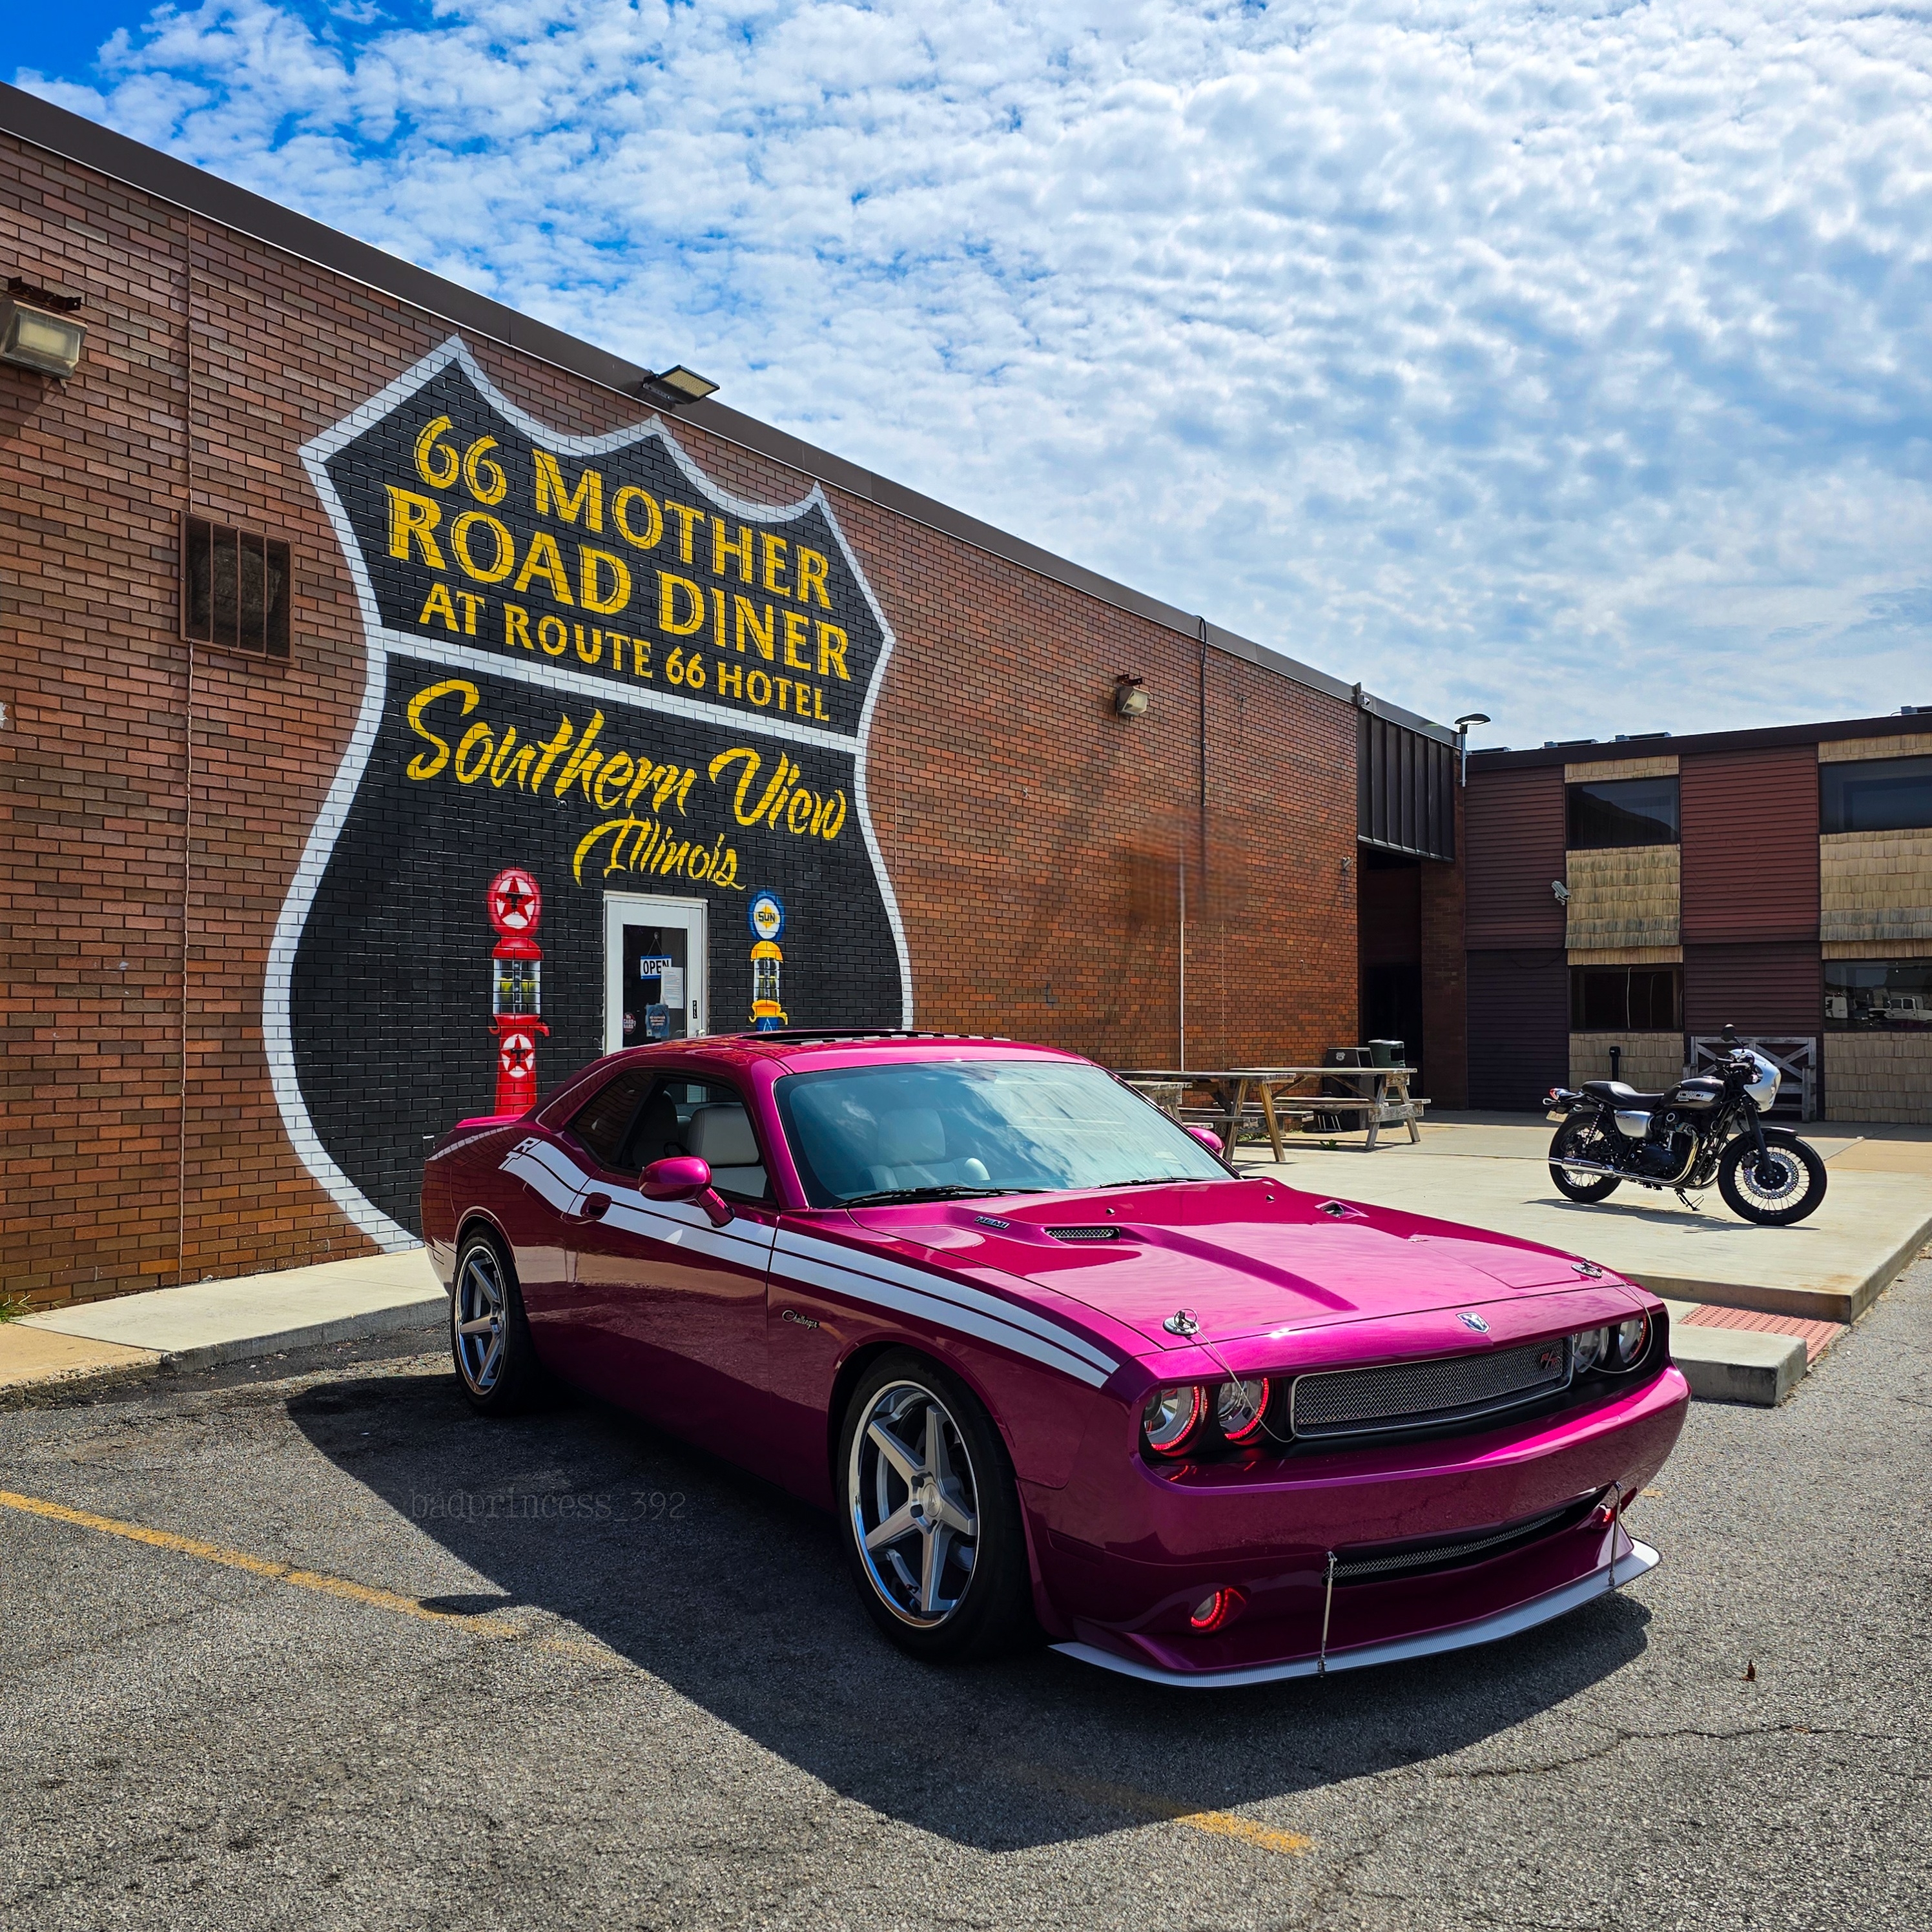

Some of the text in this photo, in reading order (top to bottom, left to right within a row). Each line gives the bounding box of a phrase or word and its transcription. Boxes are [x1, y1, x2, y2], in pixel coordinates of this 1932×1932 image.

[384, 483, 852, 681] ROAD DINER
[413, 415, 832, 610] 66 MOTHER
[418, 582, 831, 721] AT ROUTE 66 HOTEL
[406, 679, 847, 840] Southern View
[573, 811, 747, 890] Illinois
[758, 911, 776, 923] SUN
[974, 1215, 1011, 1229] HEMI
